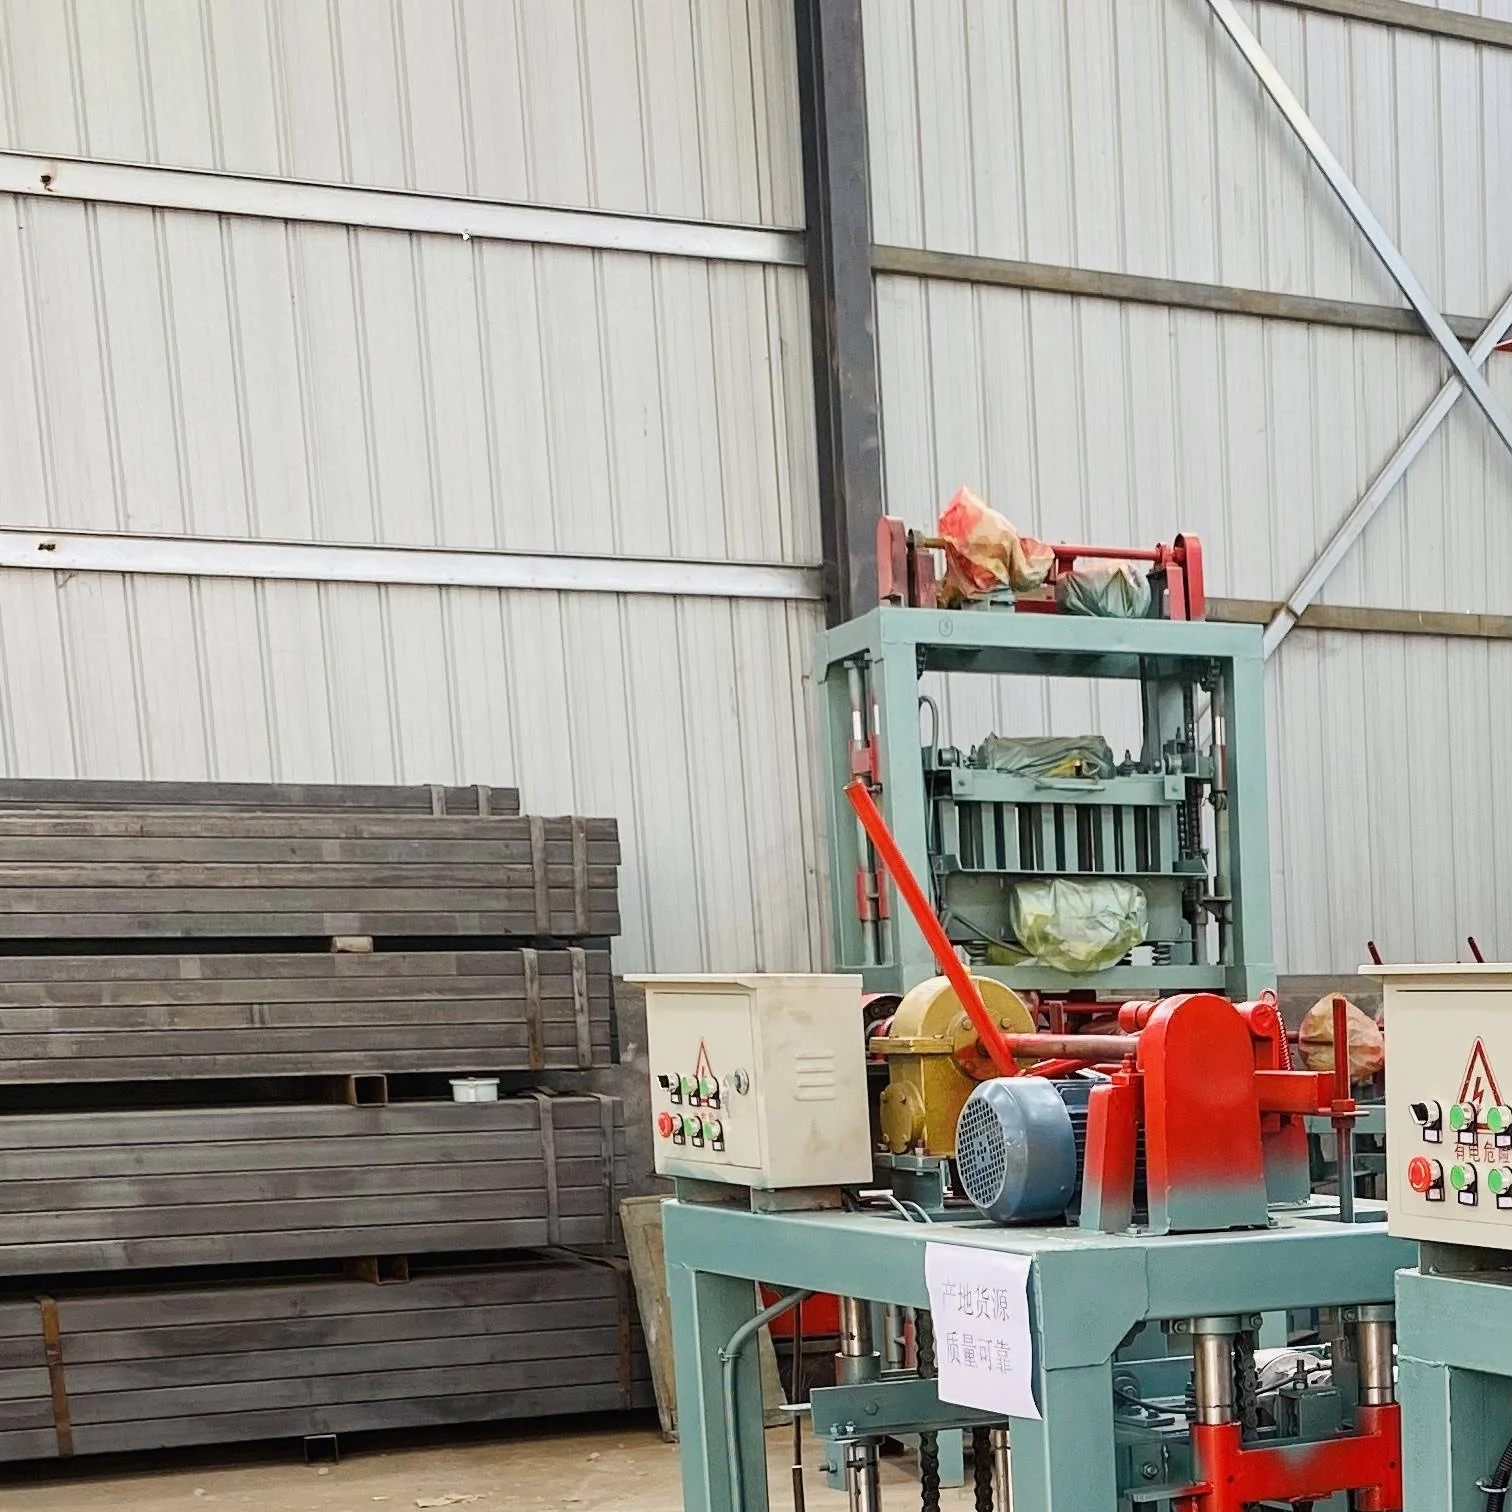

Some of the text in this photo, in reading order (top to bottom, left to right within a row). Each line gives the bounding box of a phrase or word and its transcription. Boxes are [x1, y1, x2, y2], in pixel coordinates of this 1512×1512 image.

[942, 1279, 1010, 1322] 产地货源
[946, 1331, 1012, 1375] 质量可靠
